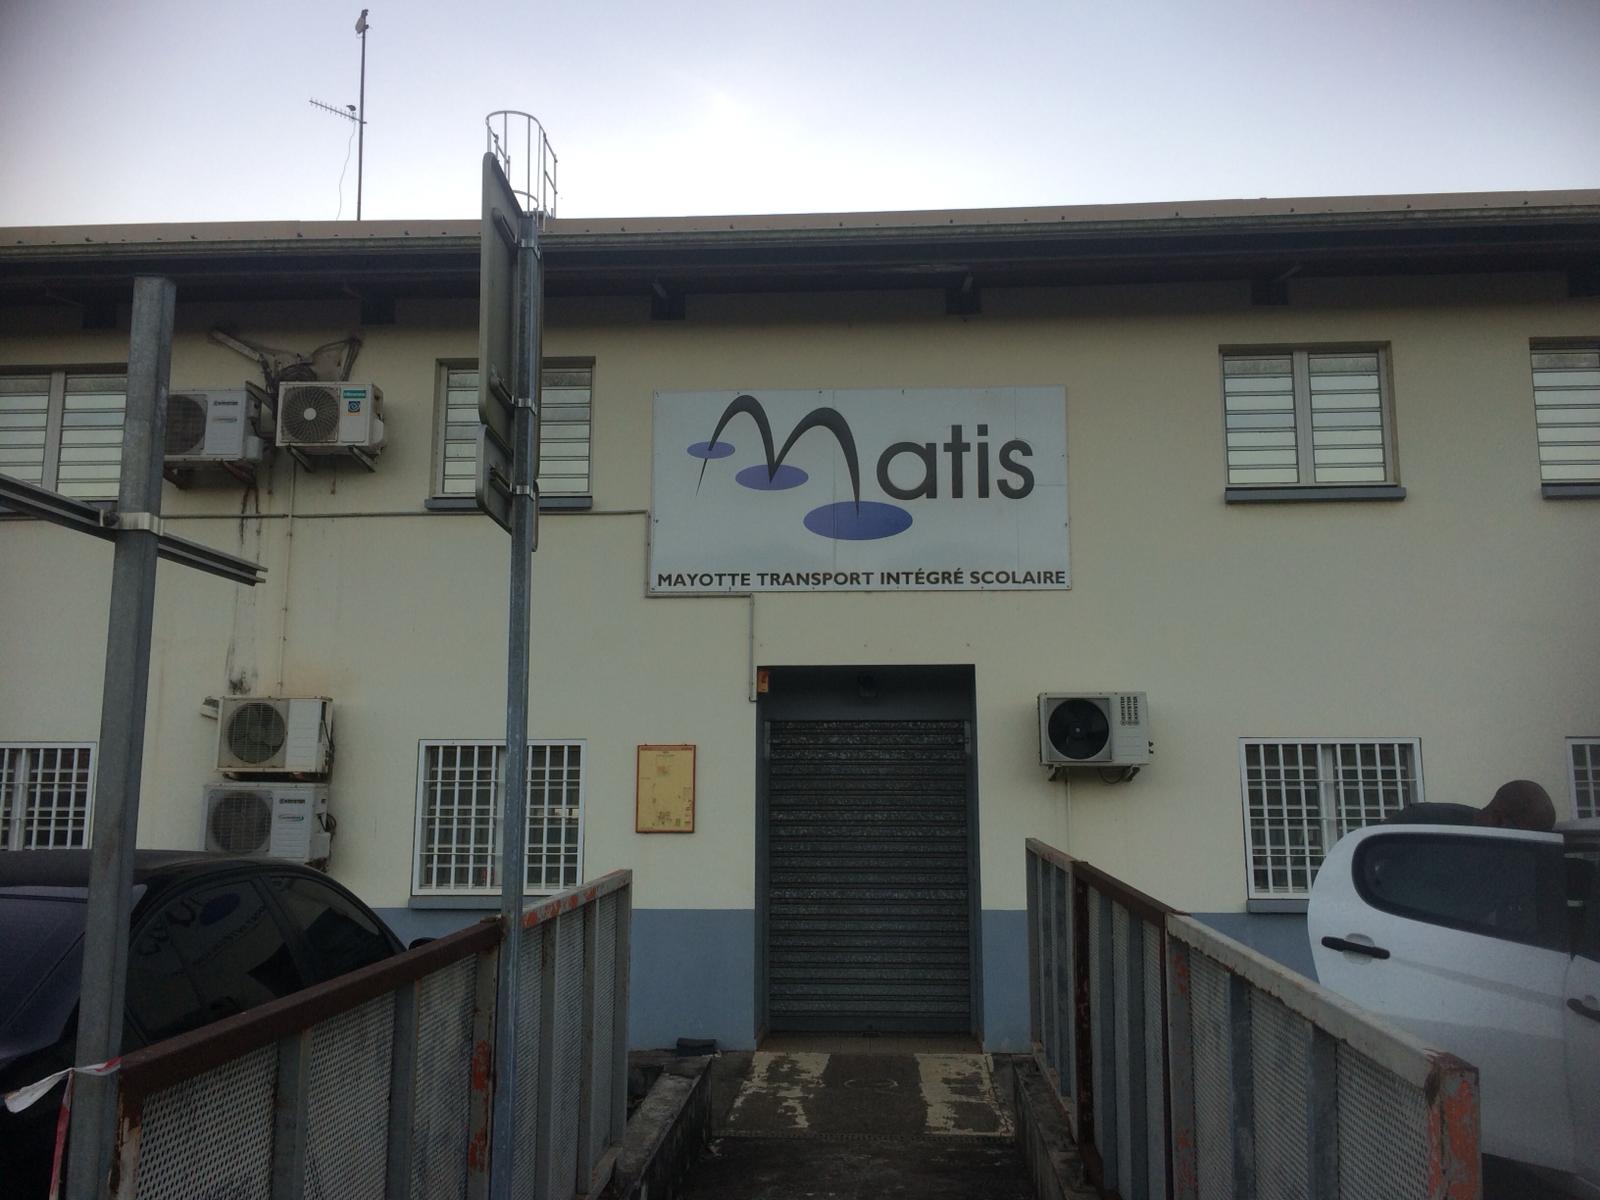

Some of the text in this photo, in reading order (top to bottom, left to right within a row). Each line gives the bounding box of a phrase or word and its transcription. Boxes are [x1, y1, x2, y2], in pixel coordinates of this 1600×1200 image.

[695, 394, 1035, 518] Matis
[657, 567, 1066, 587] MAYOTTE TRANSPORT INTÉGRÉ SCOLAIRE
